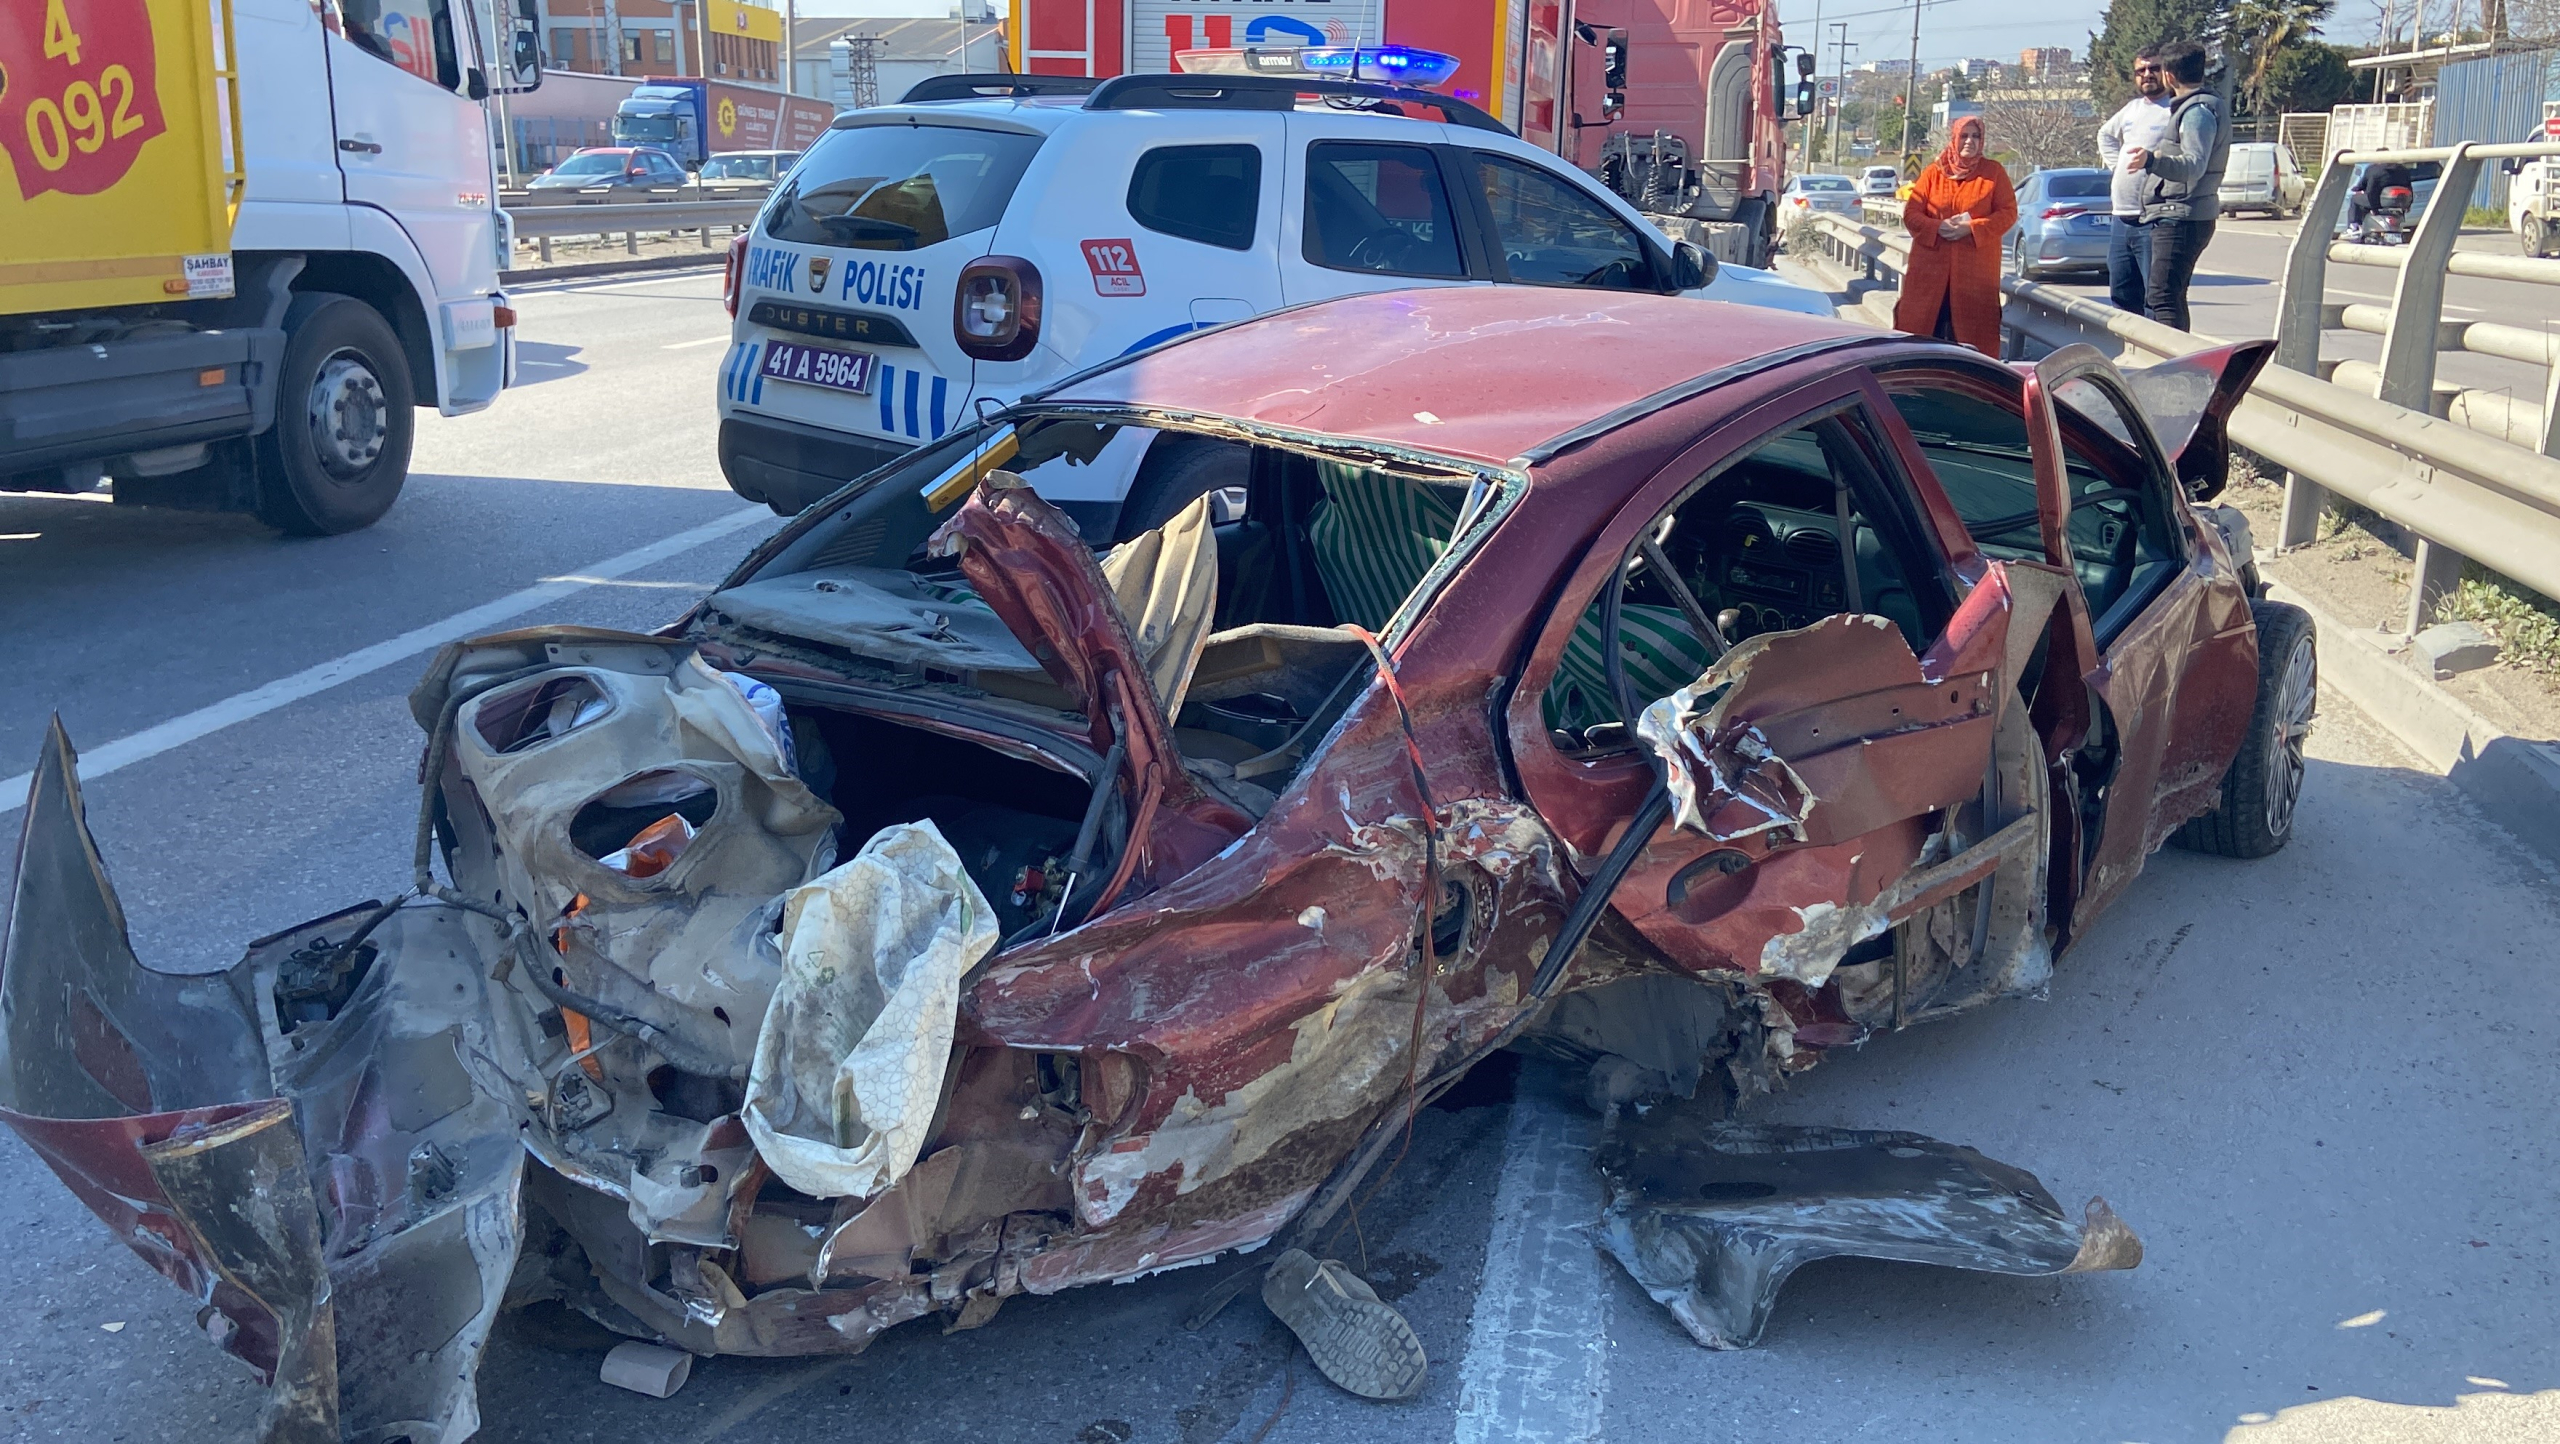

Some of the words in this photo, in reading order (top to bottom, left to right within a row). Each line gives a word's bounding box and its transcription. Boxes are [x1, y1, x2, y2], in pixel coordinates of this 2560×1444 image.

[26, 64, 145, 171] 092
[187, 257, 228, 272] ŞAHBAY
[1090, 245, 1134, 271] 112
[766, 306, 869, 334] DUSTER
[769, 346, 793, 376] 41
[795, 350, 810, 380] A
[814, 353, 863, 388] 5964
